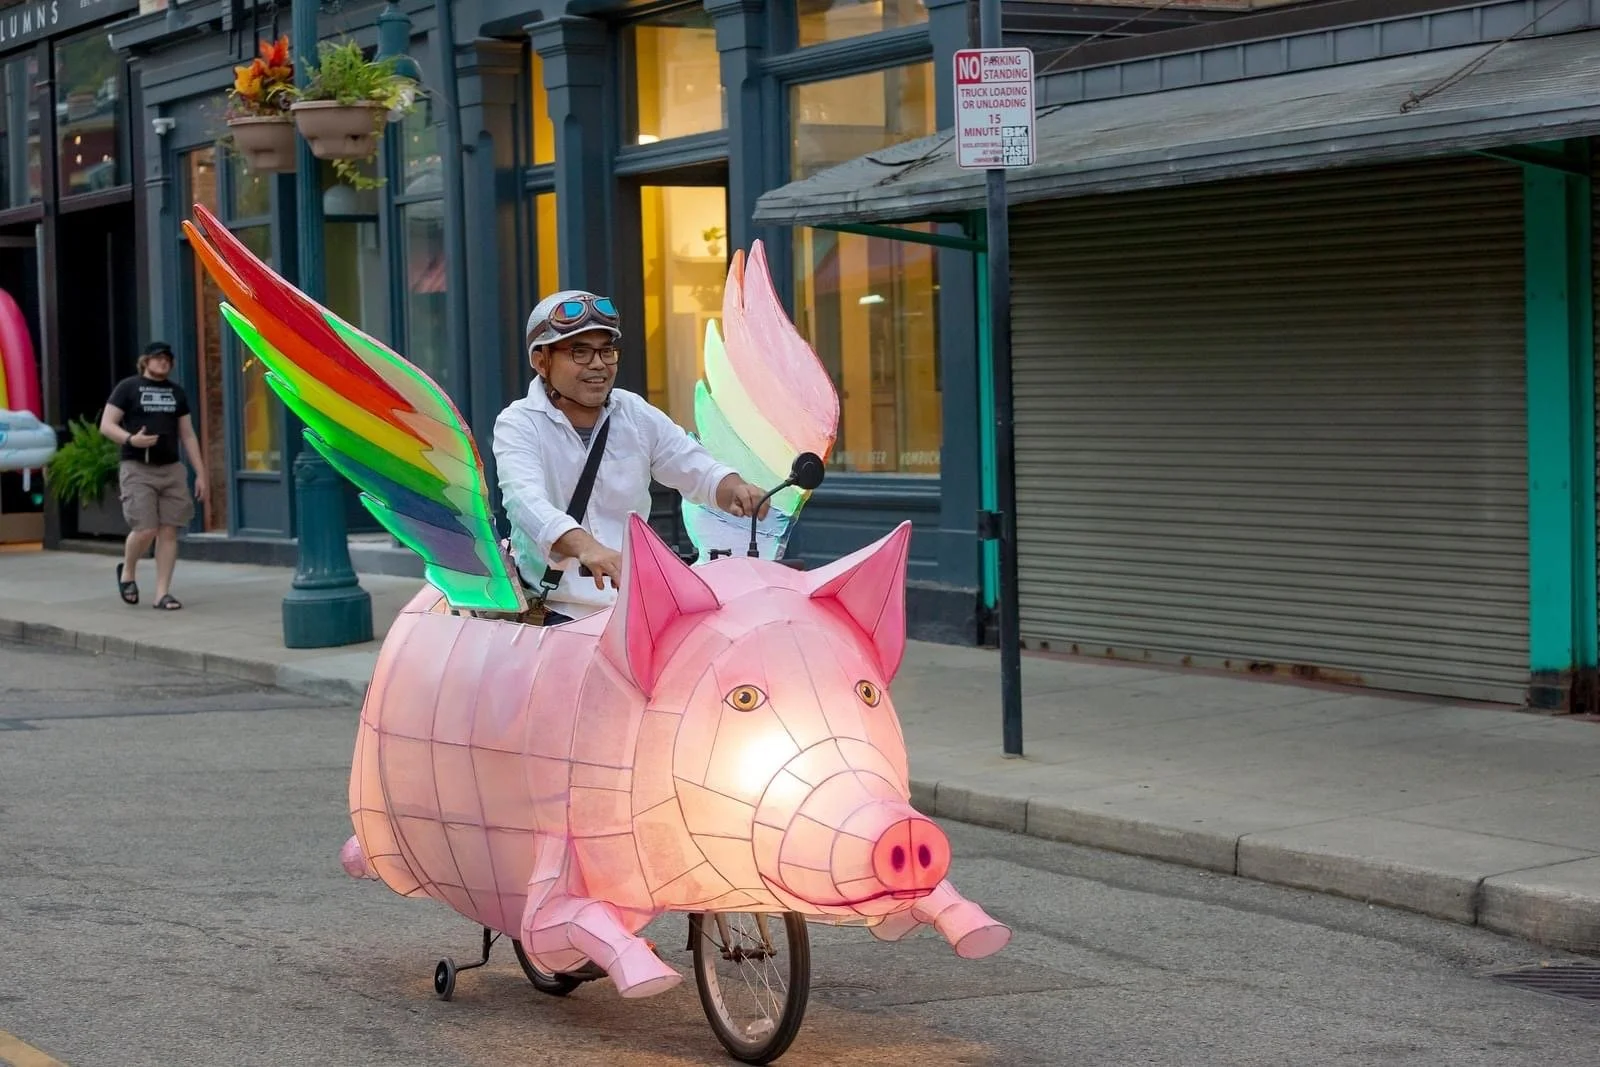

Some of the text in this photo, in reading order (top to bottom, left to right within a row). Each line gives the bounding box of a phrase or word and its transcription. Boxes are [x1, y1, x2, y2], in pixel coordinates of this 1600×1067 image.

[983, 55, 1021, 66] PARKING
[958, 56, 980, 80] NO
[983, 68, 1028, 80] STANDING
[960, 86, 1028, 98] TRUCK LOADING
[962, 98, 1026, 109] OR UNLOADING
[989, 114, 1001, 124] 15
[964, 127, 1000, 137] MINUTE
